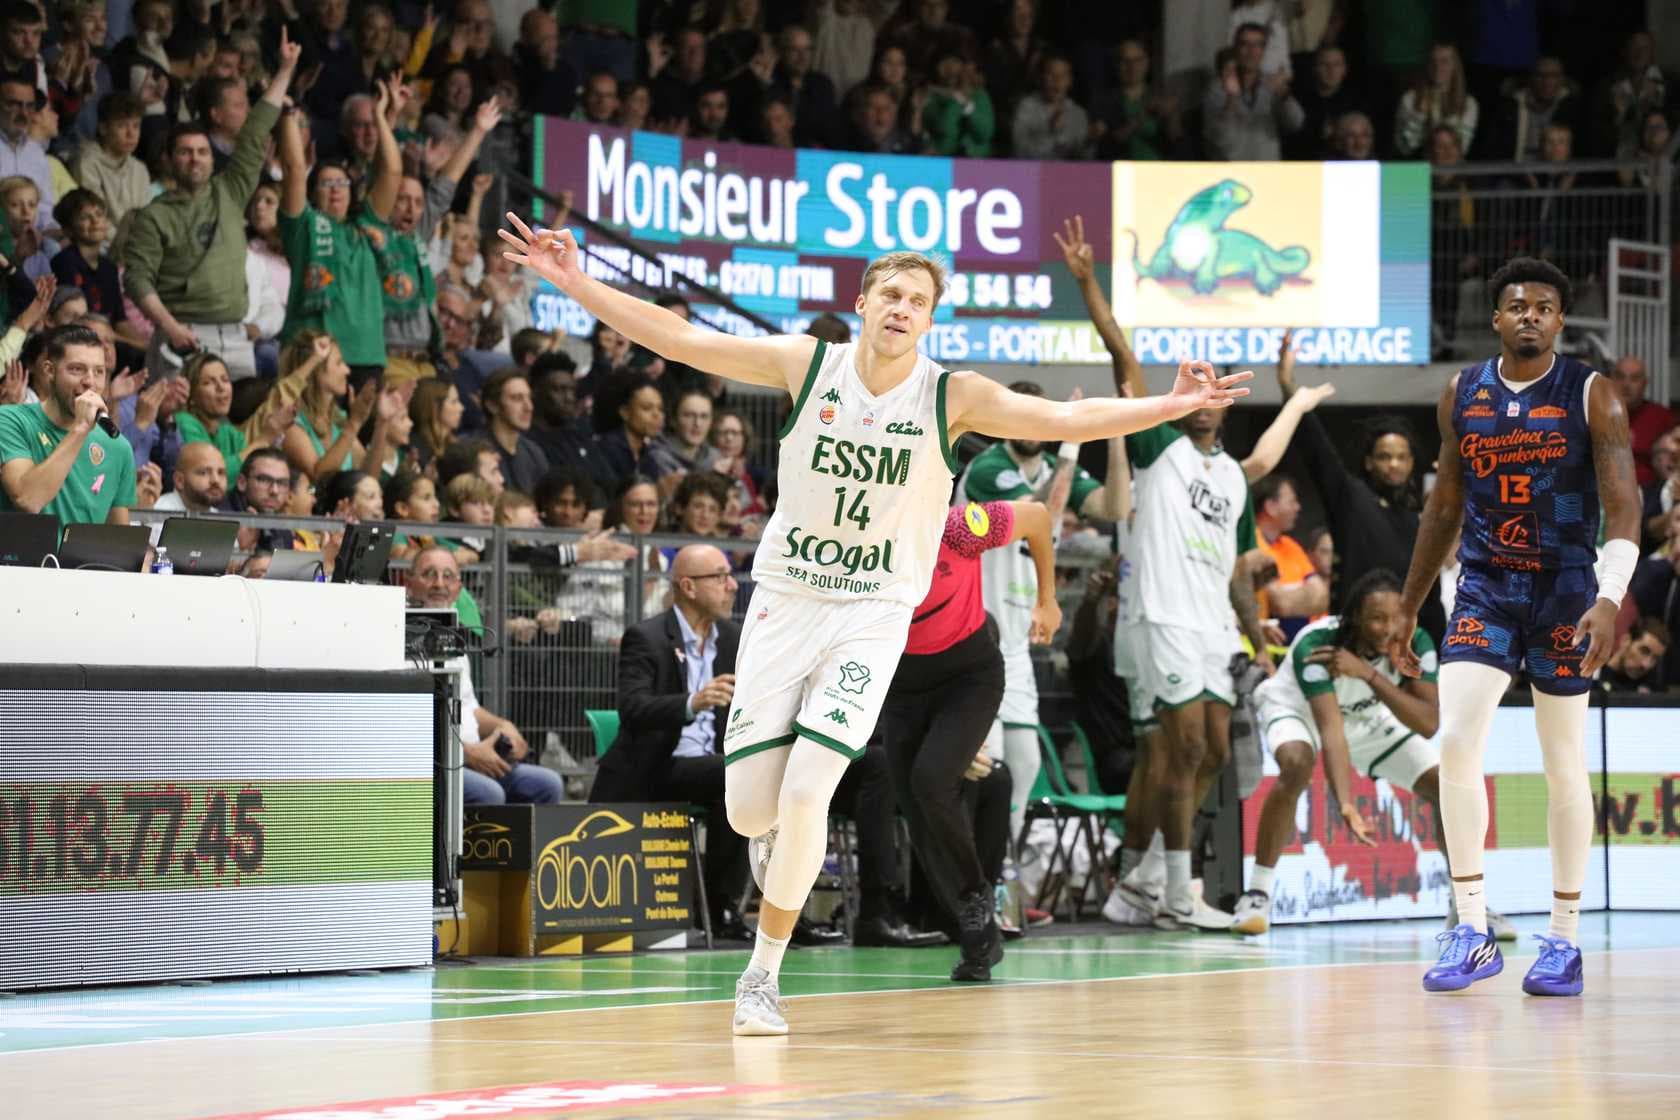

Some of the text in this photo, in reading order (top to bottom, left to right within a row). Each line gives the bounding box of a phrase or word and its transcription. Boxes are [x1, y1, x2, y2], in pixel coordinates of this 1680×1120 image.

[587, 133, 1023, 256] Monsieur Store
[973, 274, 1010, 308] 54
[1014, 274, 1052, 311] 54
[1134, 328, 1234, 362] PORTES
[1298, 329, 1412, 362] GARAGE
[811, 434, 912, 486] ESSM
[1460, 428, 1544, 458] Gravelines
[1472, 445, 1567, 478] Dunkerque
[1498, 474, 1532, 504] 13
[833, 486, 871, 531] 14
[782, 526, 893, 576] Scogal
[785, 565, 881, 594] SEA SOLUTIONS
